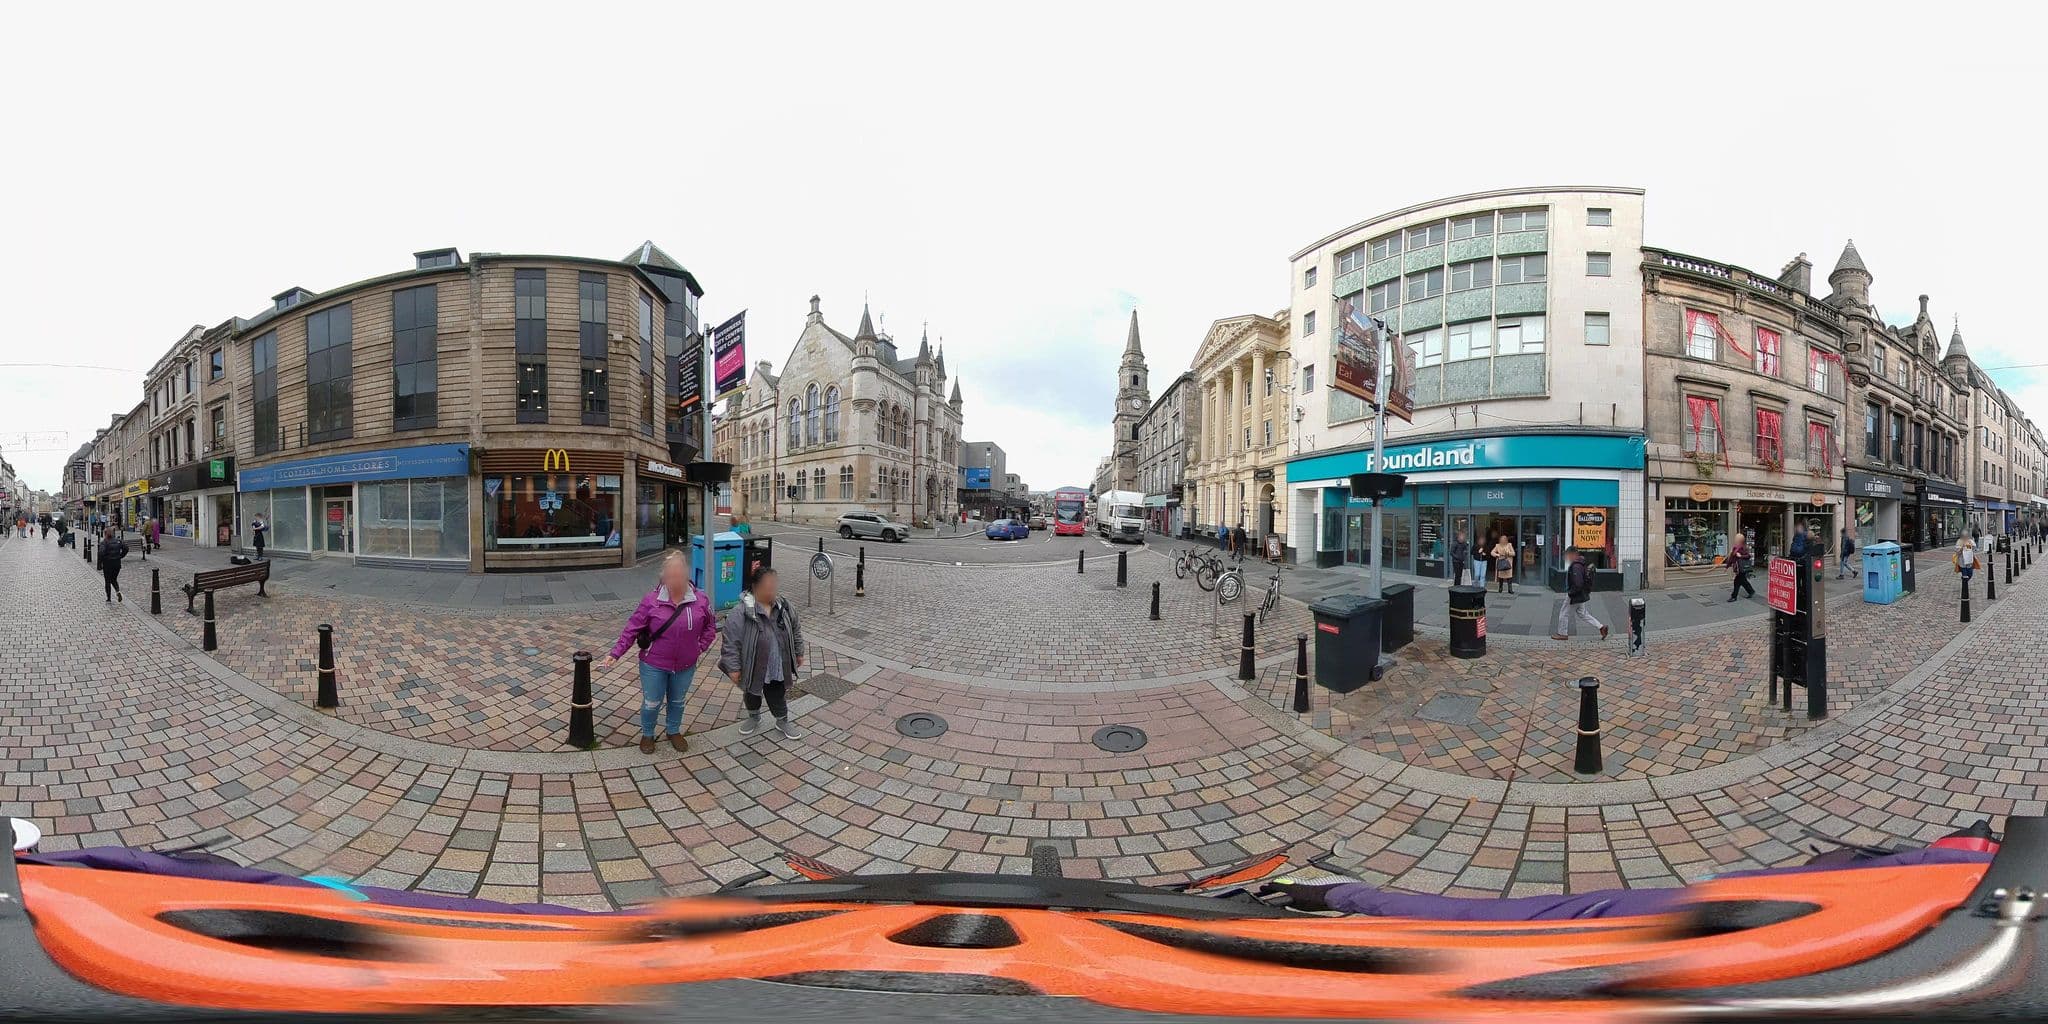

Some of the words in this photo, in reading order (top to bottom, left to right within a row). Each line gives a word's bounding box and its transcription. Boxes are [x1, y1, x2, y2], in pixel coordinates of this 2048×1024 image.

[1339, 365, 1353, 379] Eat
[279, 467, 316, 479] SCOTTISH
[320, 463, 348, 474] HOME
[351, 460, 390, 471] STORES
[1487, 491, 1504, 499] Exit
[1746, 489, 1765, 498] House
